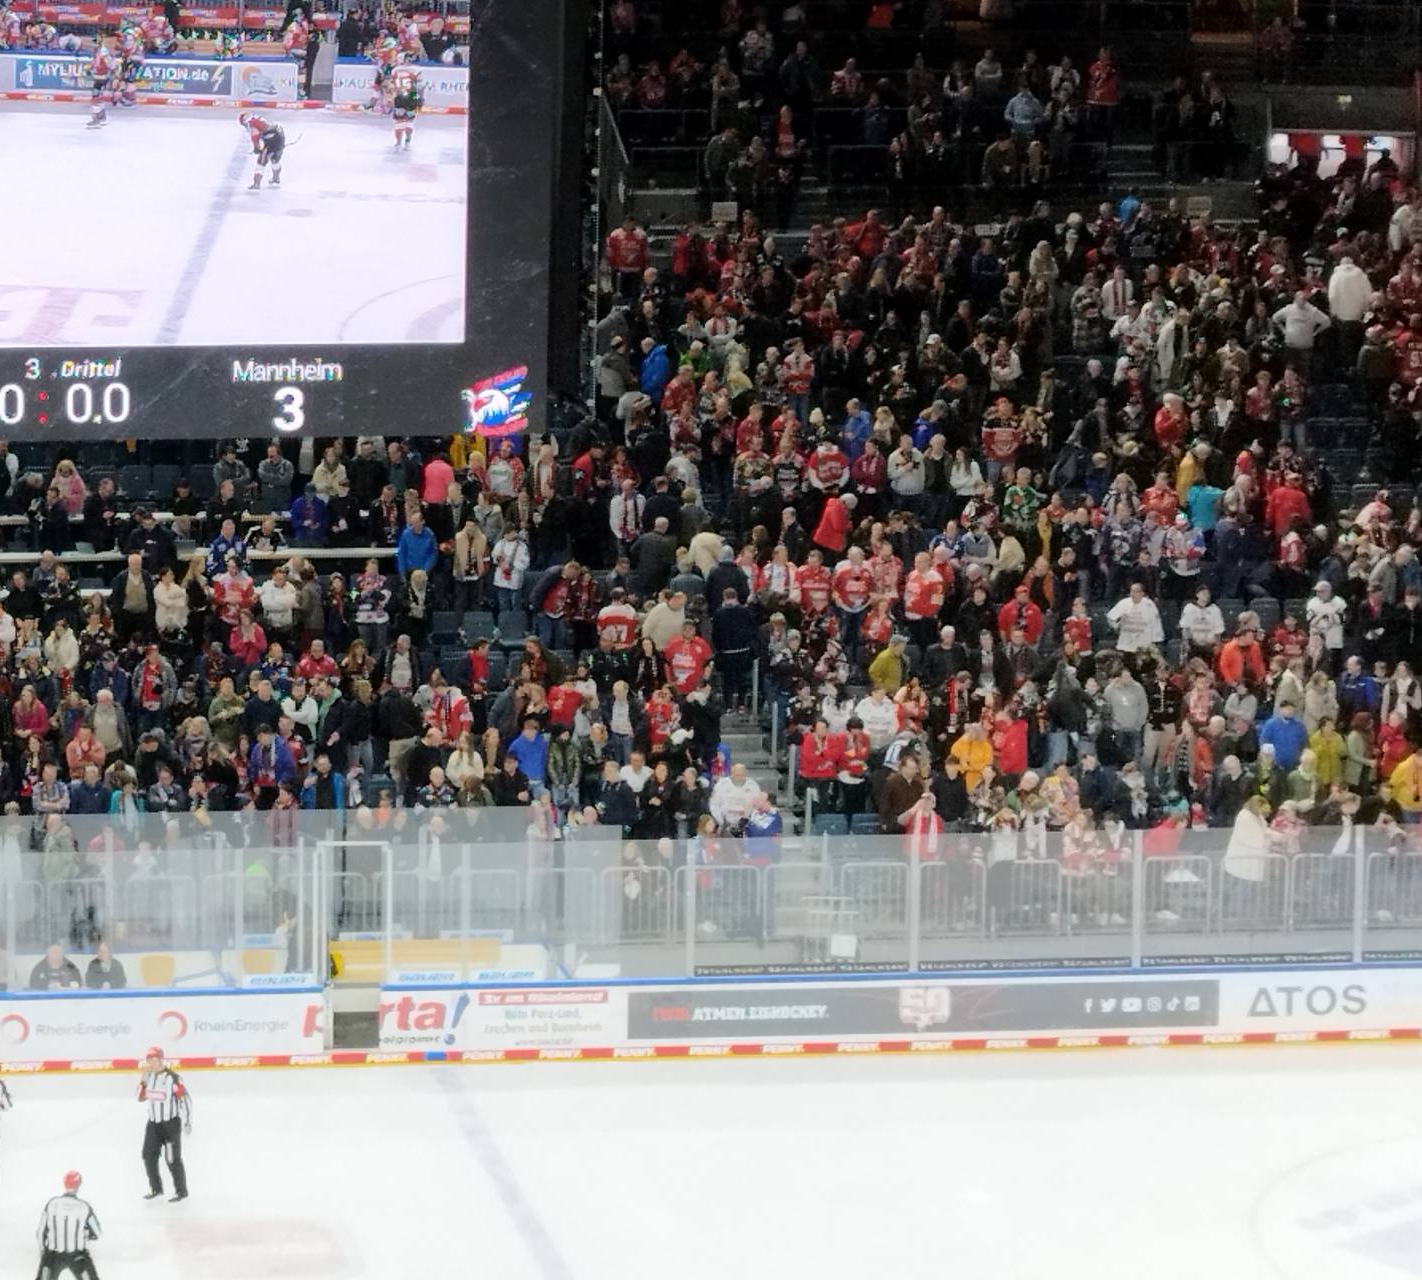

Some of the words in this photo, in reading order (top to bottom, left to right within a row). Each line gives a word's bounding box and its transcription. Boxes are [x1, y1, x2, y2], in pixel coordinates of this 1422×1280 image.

[25, 358, 40, 379] 3
[233, 358, 343, 383] Mannheim
[272, 388, 305, 432] 3
[1247, 984, 1368, 1017] ATOS
[35, 1022, 130, 1038] RheinEnergie
[194, 1018, 288, 1034] RheinEnergie
